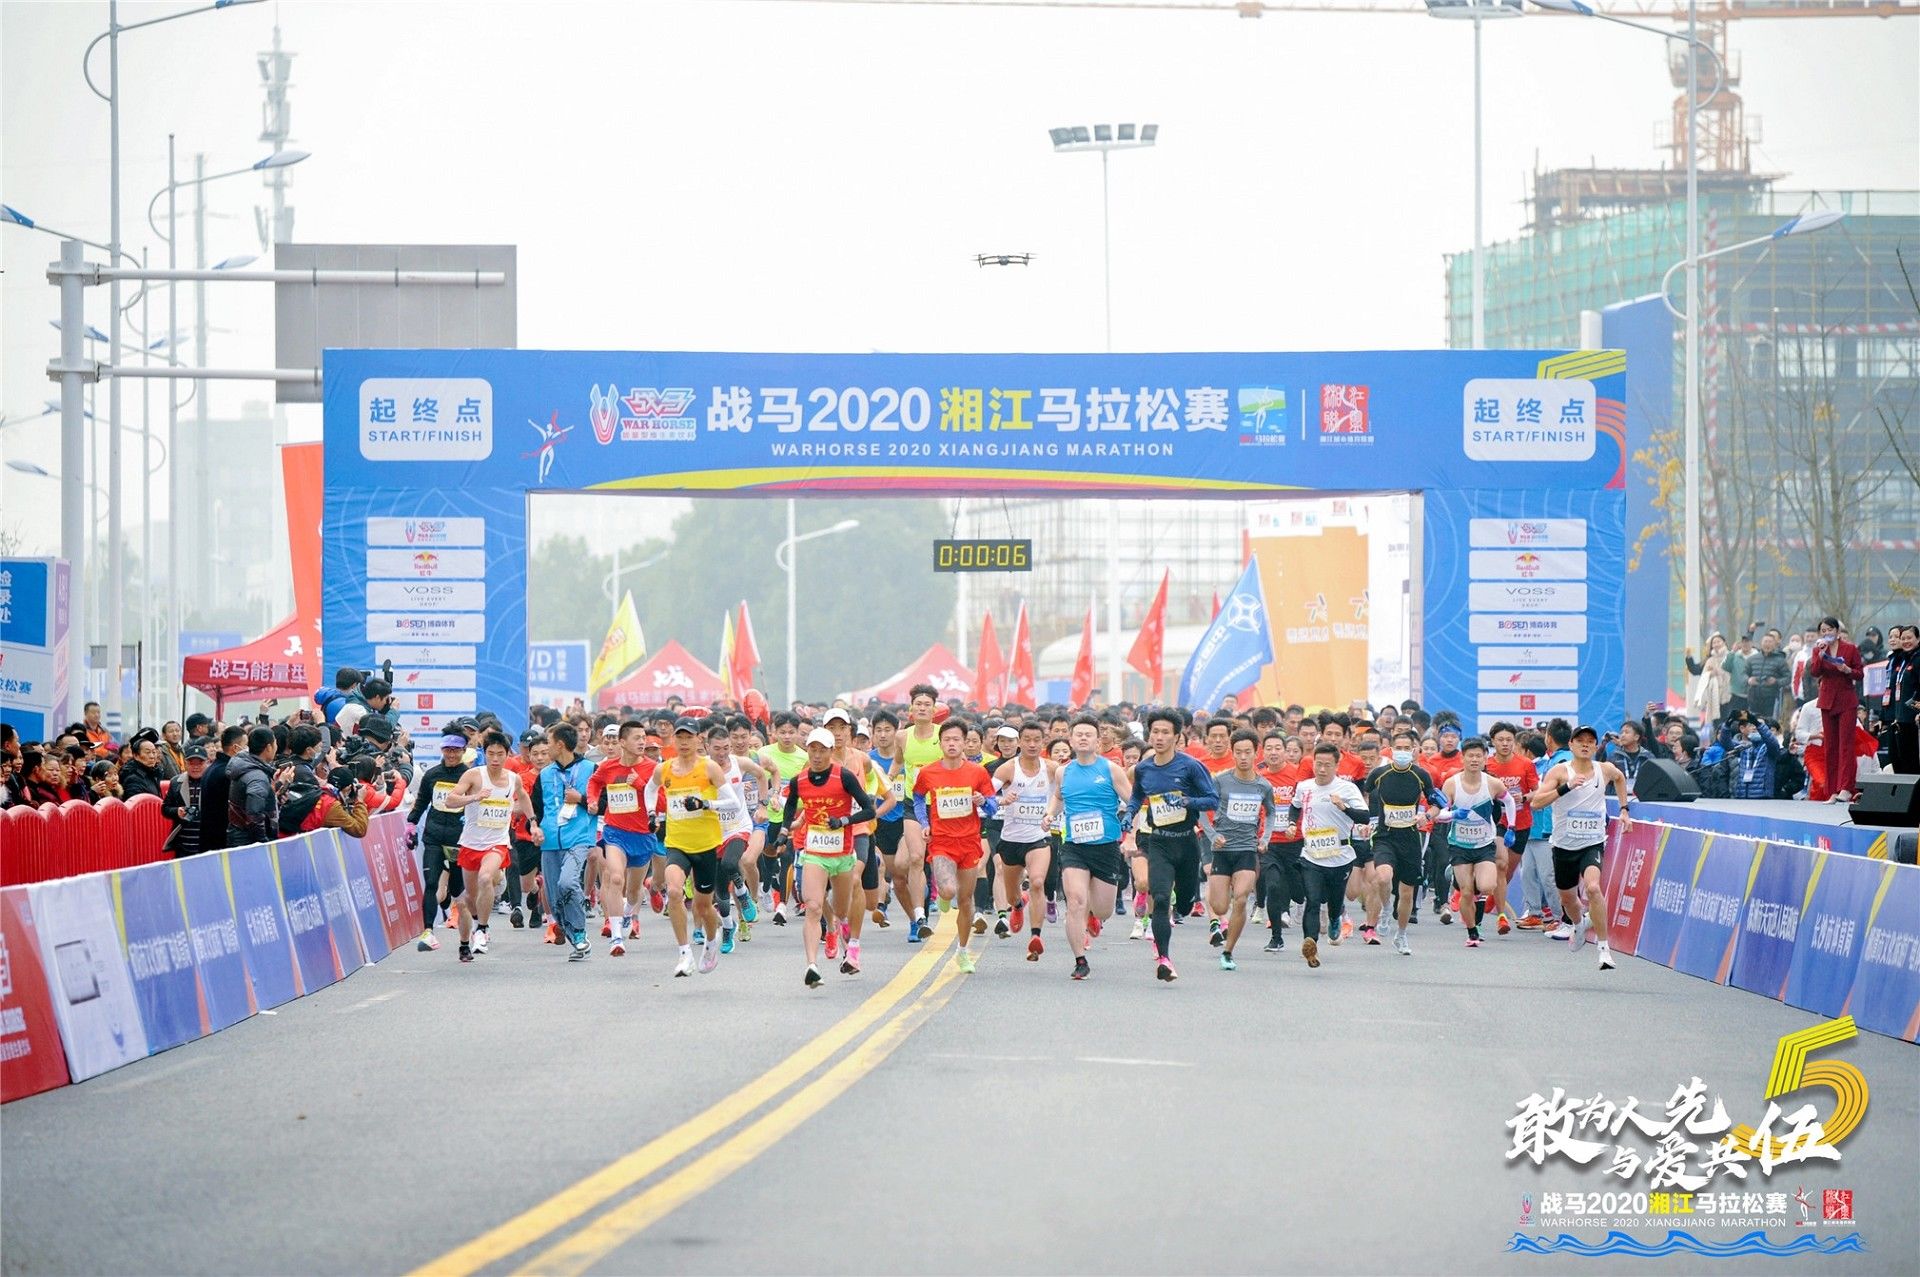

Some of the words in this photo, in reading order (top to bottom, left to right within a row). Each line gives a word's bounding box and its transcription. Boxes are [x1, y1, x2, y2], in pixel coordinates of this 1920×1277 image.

[369, 397, 482, 423] 起终点
[706, 386, 1230, 434] 战马2020湘江马拉松赛
[1473, 398, 1585, 424] 起终点
[622, 419, 649, 430] WAR
[652, 419, 695, 430] HORSE
[368, 430, 482, 442] START/FINISH
[1472, 431, 1586, 443] START/FINISH
[771, 443, 881, 457] WARHORSE
[888, 443, 932, 457] 2020
[938, 443, 1060, 457] XIANGJIANG
[1066, 443, 1175, 457] MARATHON
[938, 544, 1027, 567] 0:00:06
[403, 586, 454, 595] VOSS
[1505, 587, 1556, 596] VOSS
[610, 792, 634, 803] A1019
[942, 797, 969, 808] A1041
[1019, 805, 1045, 815] C1732
[1232, 802, 1258, 812] C1272
[482, 808, 507, 818] A1024
[718, 811, 736, 821] 1020
[1389, 811, 1413, 819] A1003
[1074, 821, 1100, 833] C1677
[1459, 826, 1482, 835] C1151
[1571, 820, 1598, 830] C1132
[811, 836, 841, 846] A1046
[1310, 838, 1336, 849] A1025
[1811, 912, 1855, 958] 长沙市体育局
